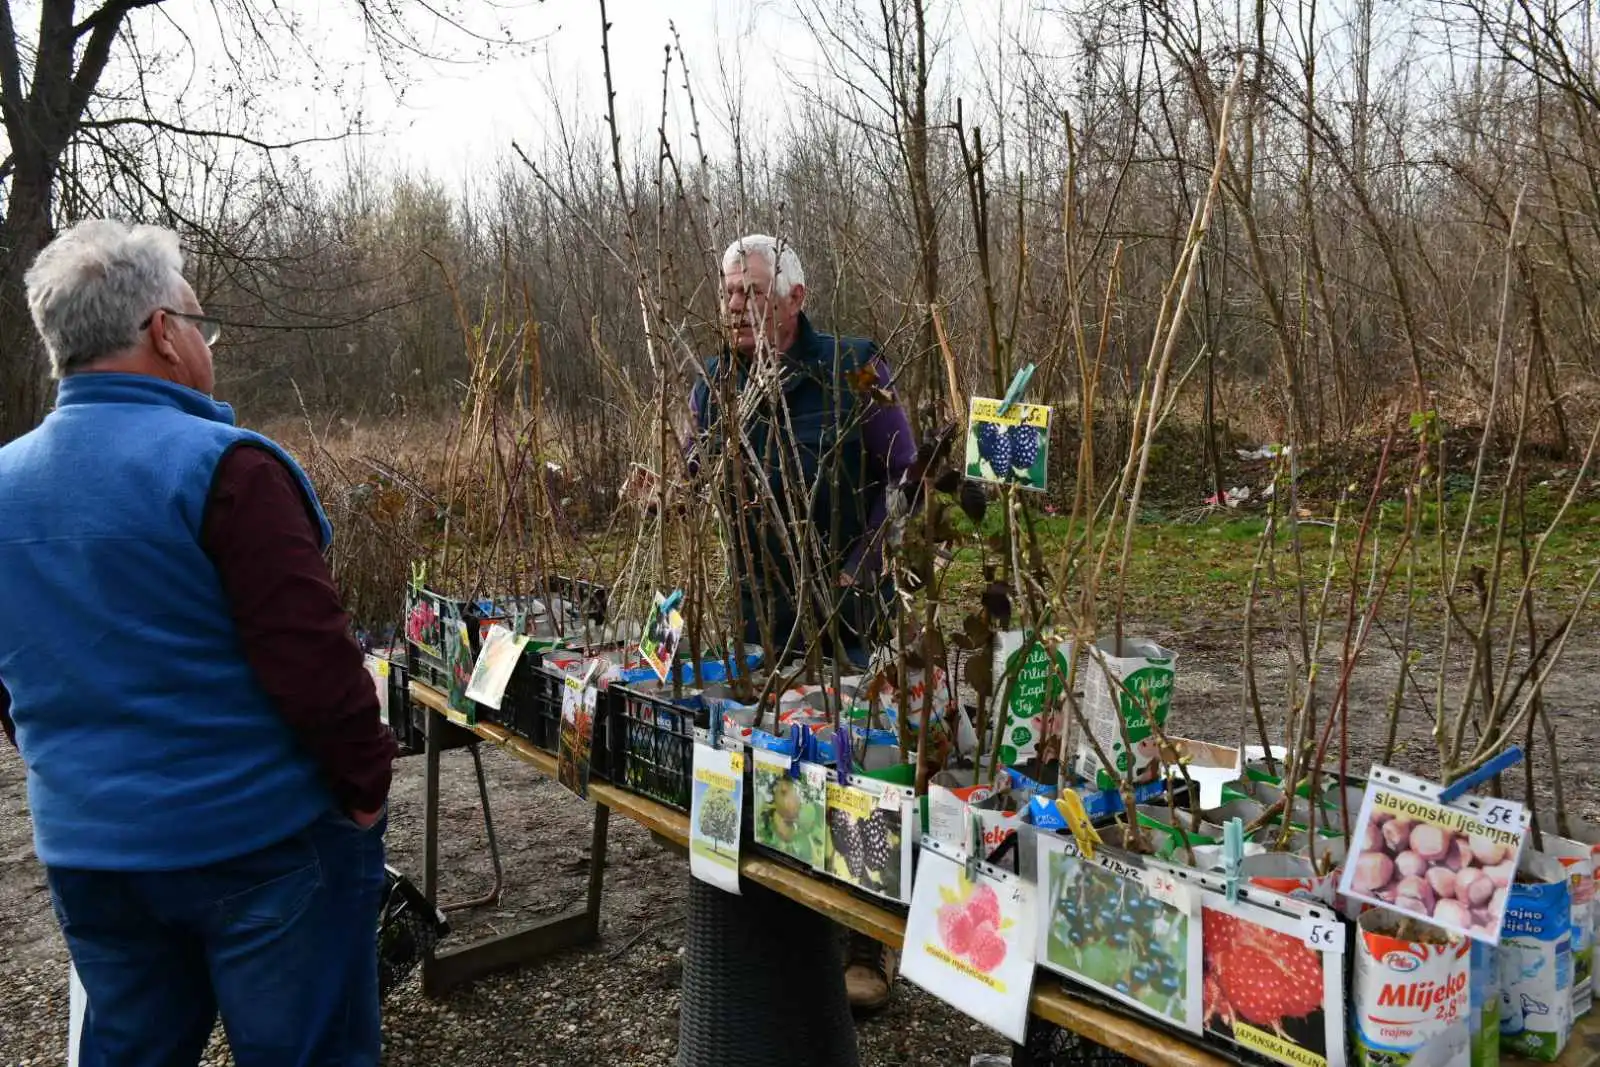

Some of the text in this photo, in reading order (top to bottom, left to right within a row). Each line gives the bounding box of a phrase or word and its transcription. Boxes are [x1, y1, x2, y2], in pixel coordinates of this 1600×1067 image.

[1374, 791, 1452, 826] slavonski
[1485, 804, 1513, 825] 5€
[1309, 924, 1335, 944] 5€
[1376, 971, 1467, 1013] Mlijeko
[1234, 1026, 1283, 1056] JAPANSKA
[1380, 1026, 1414, 1041] trajno
